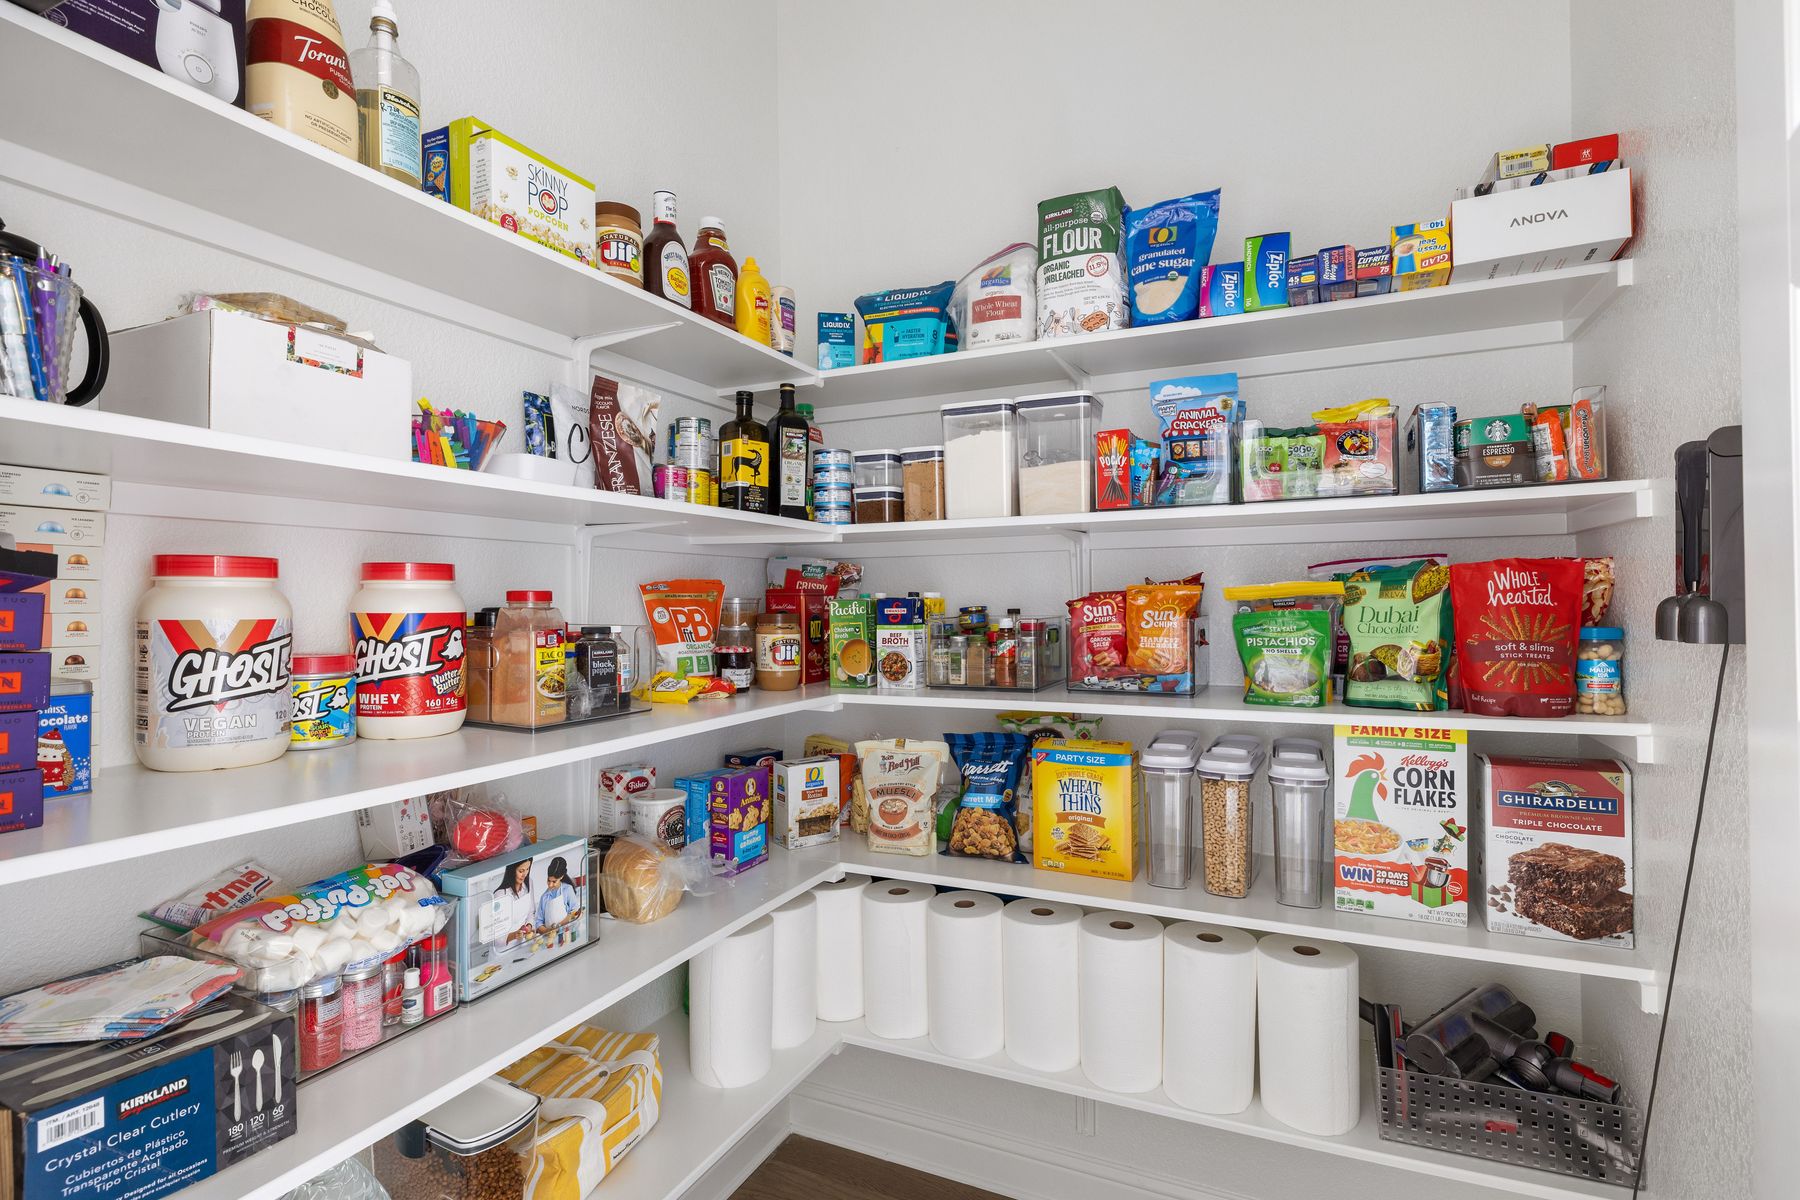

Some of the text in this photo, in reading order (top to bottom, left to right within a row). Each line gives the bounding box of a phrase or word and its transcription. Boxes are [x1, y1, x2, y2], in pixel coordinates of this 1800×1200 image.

[294, 35, 346, 70] Torani
[528, 181, 568, 220] POP
[528, 207, 568, 231] POPCORN
[1045, 209, 1073, 220] KIRKLAND
[1510, 209, 1569, 228] ANOVA
[1043, 217, 1089, 234] all-purpose
[1430, 219, 1445, 228] 140
[603, 233, 638, 246] NATURAL
[1043, 227, 1102, 259] FLOUR
[1419, 237, 1437, 247] Seal
[1139, 248, 1185, 262] granulated
[1357, 249, 1383, 257] Reynolds
[1357, 254, 1390, 265] CUT-RITE
[1043, 260, 1070, 275] ORGANIC
[1131, 258, 1196, 276] cane sugar
[1421, 254, 1449, 268] GLAD
[1044, 269, 1085, 285] UNBLEACHED
[1267, 253, 1284, 289] Ziploc
[1330, 264, 1338, 281] Wrap
[980, 278, 1011, 287] organics
[885, 291, 919, 301] LIQUID
[1221, 272, 1238, 308] Ziploc
[974, 300, 1018, 313] Whole Wheat
[985, 309, 1005, 318] Flour
[1179, 410, 1217, 420] ANIMAL
[1173, 417, 1226, 430] CRACKERS
[1483, 447, 1515, 456] ESPRESSO
[1494, 567, 1540, 591] WHOLE
[830, 601, 866, 616] Pacific
[1083, 604, 1113, 623] Sun
[1360, 605, 1419, 623] Dubai
[669, 607, 713, 642] PB
[1141, 609, 1179, 629] Sun
[683, 628, 696, 642] fit
[810, 621, 822, 639] RITZ
[1357, 623, 1419, 634] Chocolate
[881, 637, 909, 645] BROTH
[1246, 637, 1316, 647] PISTACHIOS
[1495, 643, 1517, 651] soft
[1529, 643, 1554, 653] slims
[357, 628, 450, 683] GHOST
[540, 651, 563, 659] TACO
[592, 660, 613, 668] black
[171, 637, 291, 709] GHOST
[432, 672, 458, 685] Nutter
[592, 667, 615, 676] pepper
[437, 678, 461, 695] Butter
[359, 694, 441, 707] WHEY 160
[39, 714, 88, 727] ocolate
[184, 714, 257, 732] VEGAN
[187, 731, 225, 739] PROTEIN
[1351, 725, 1451, 739] FAMILY SIZE
[888, 756, 921, 773] Red Mill
[1056, 754, 1105, 764] PARTY SIZE
[1401, 754, 1448, 770] Kellogg's
[962, 760, 1013, 776] Garrett
[1087, 772, 1103, 780] GRAIN
[1393, 767, 1455, 790] CORN
[628, 781, 647, 791] Fisher
[877, 788, 915, 798] MUESLI
[1057, 779, 1101, 795] WHEAT
[741, 793, 761, 807] Annie's
[1394, 788, 1456, 808] FLAKES
[1503, 795, 1612, 811] GHIRARDELLI
[1068, 815, 1092, 823] original
[1512, 818, 1602, 832] TRIPLE CHOCOLATE
[1496, 834, 1533, 842] CHOCOLATE
[1341, 866, 1373, 882] WIN
[1376, 870, 1408, 880] 20 DAYS
[1386, 879, 1408, 887] PRIZES
[262, 871, 415, 932] Jet-Puffed
[121, 1079, 187, 1112] KIRKLAND
[272, 1105, 284, 1116] 60
[250, 1113, 265, 1126] 120
[228, 1123, 243, 1137] 180
[45, 1103, 200, 1172] Crystal Clear Cutlery
[223, 1142, 244, 1154] PREMIUM
[65, 1130, 185, 1185] Cubiertos de Plástico
[61, 1138, 188, 1197] Transparente Acabado
[95, 1160, 160, 1194] Tipo Cristal
[124, 1181, 156, 1199] Designed
[157, 1176, 166, 1185] for
[177, 1158, 208, 1175] Occasions
